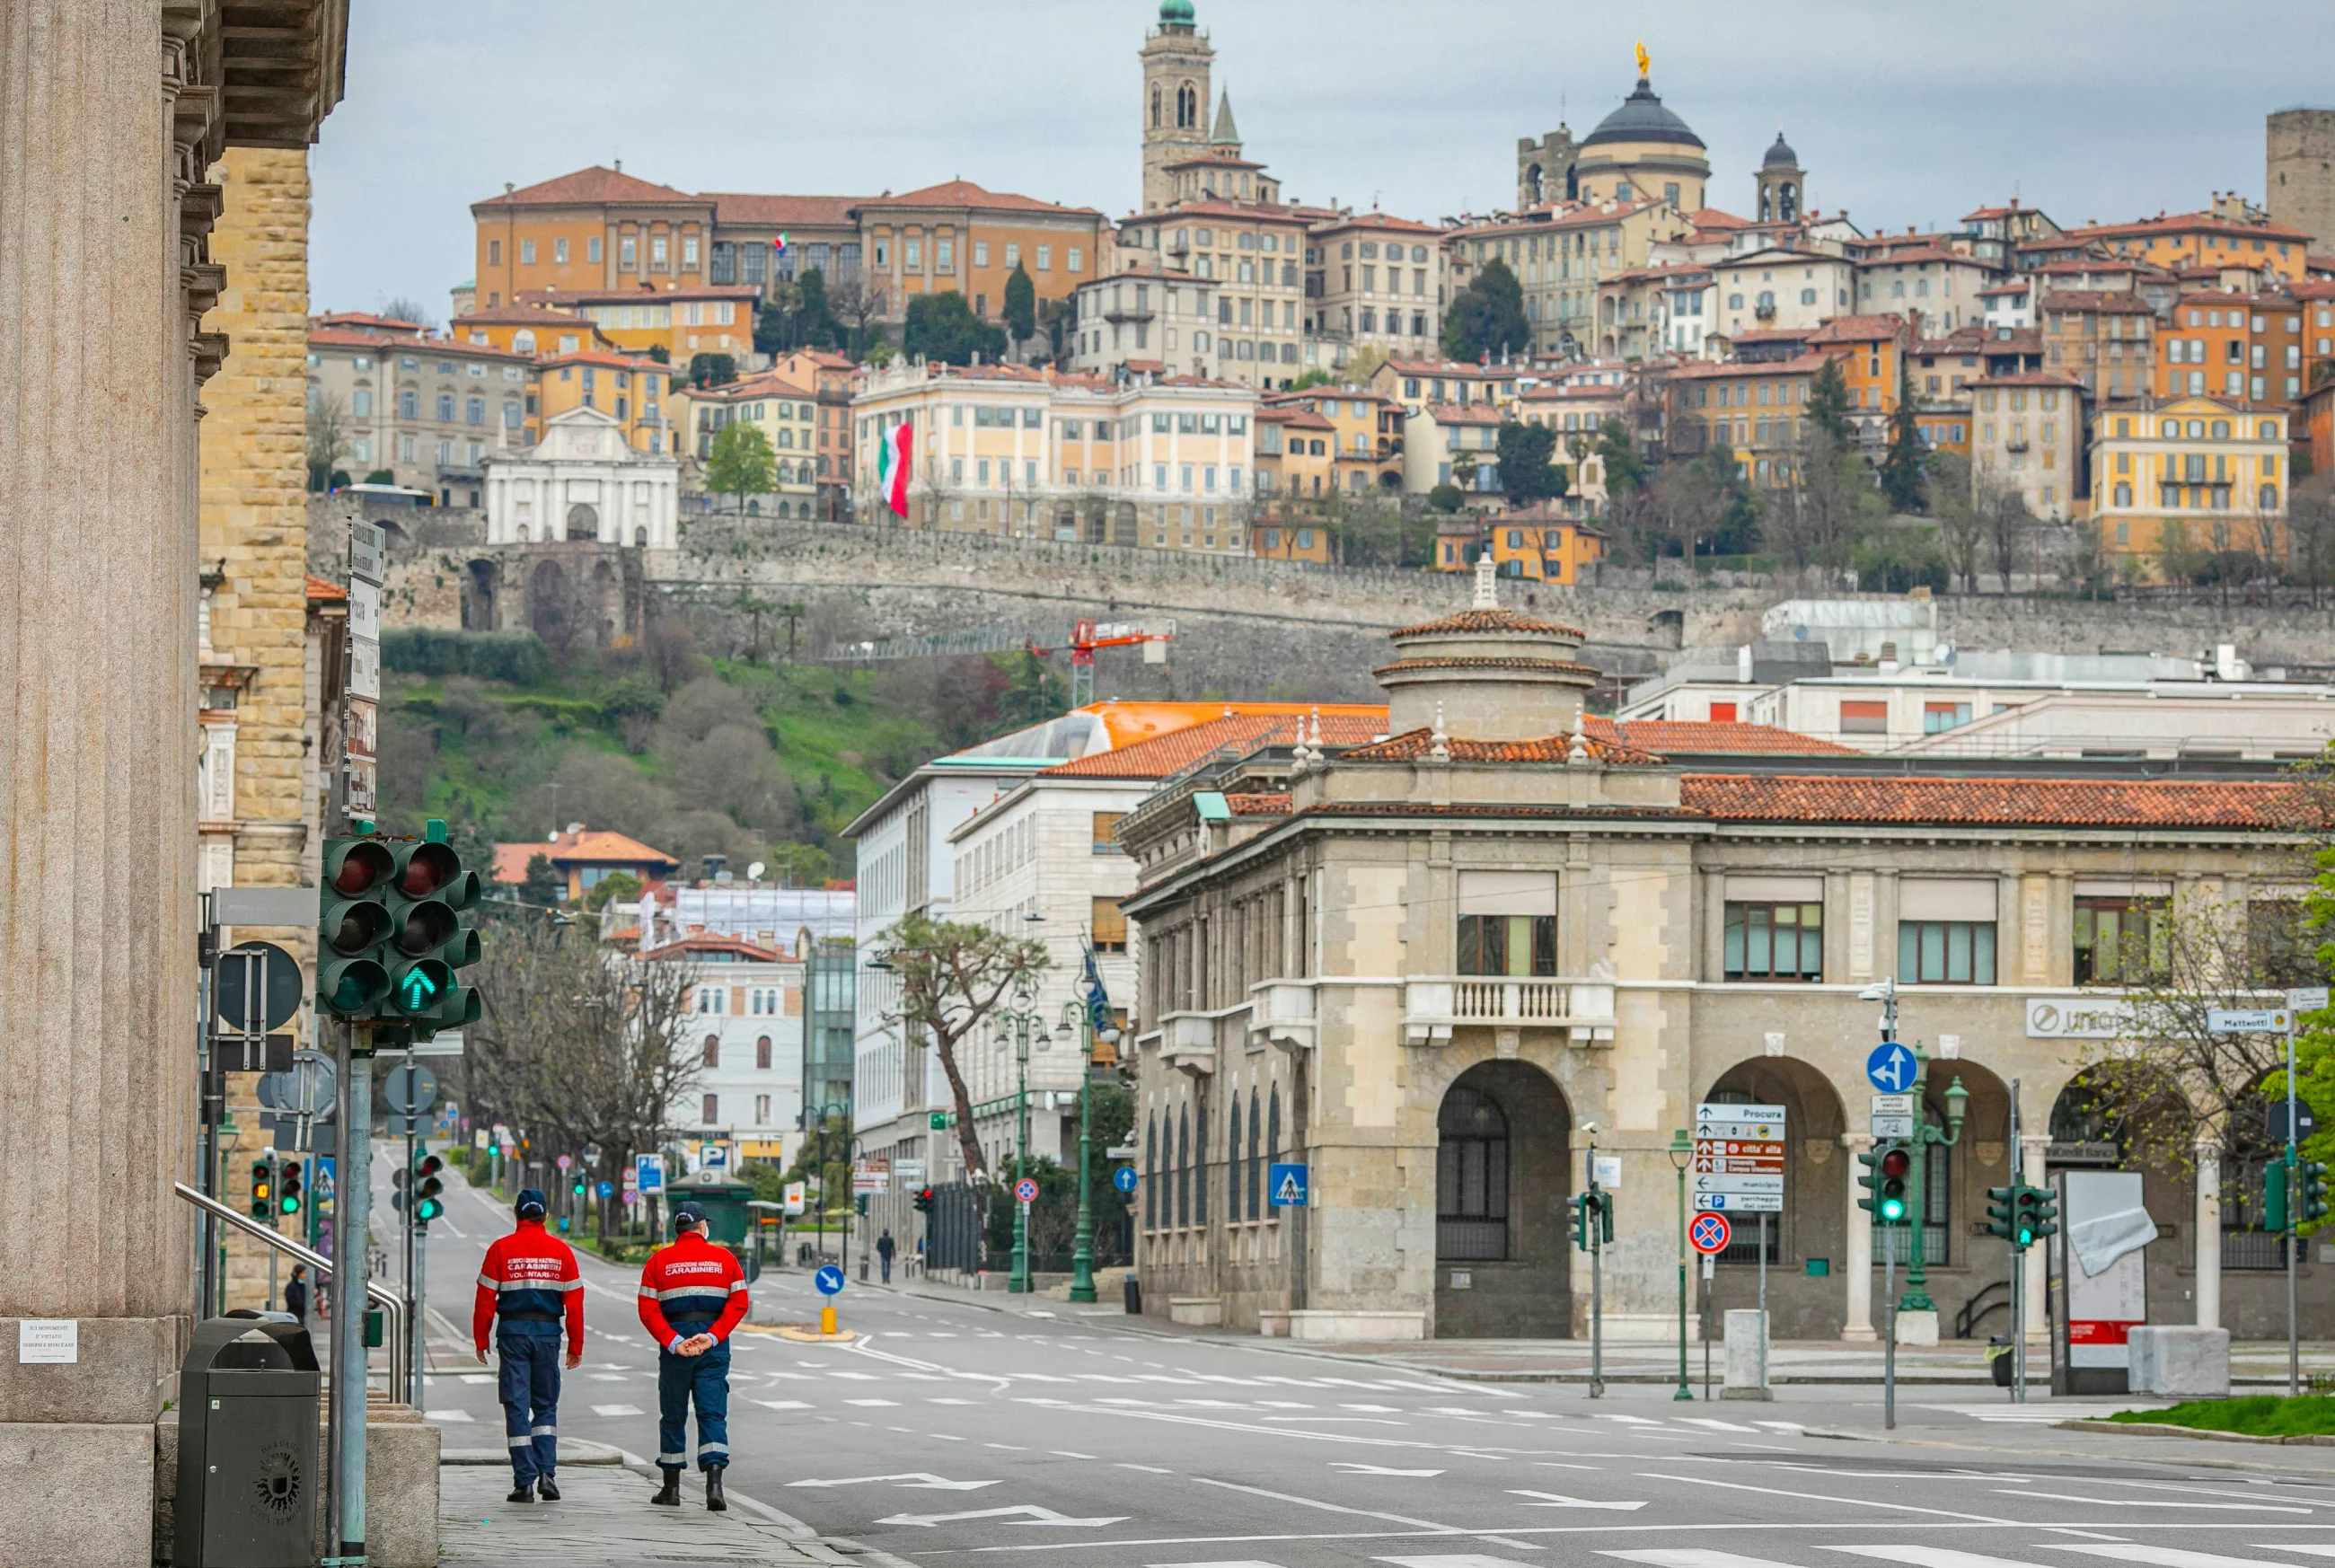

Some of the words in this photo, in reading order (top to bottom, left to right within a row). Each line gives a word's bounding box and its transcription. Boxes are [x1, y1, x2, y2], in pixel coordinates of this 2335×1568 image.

[2224, 1018, 2268, 1027] Matteotti
[1743, 1109, 1782, 1119] Procura
[1765, 1144, 1782, 1154] alta
[507, 1264, 562, 1272] CARABINIERI
[665, 1267, 723, 1276] CARABINIERI
[509, 1272, 560, 1280] VOLONTARIATO
[261, 1440, 300, 1454] BERGAMO
